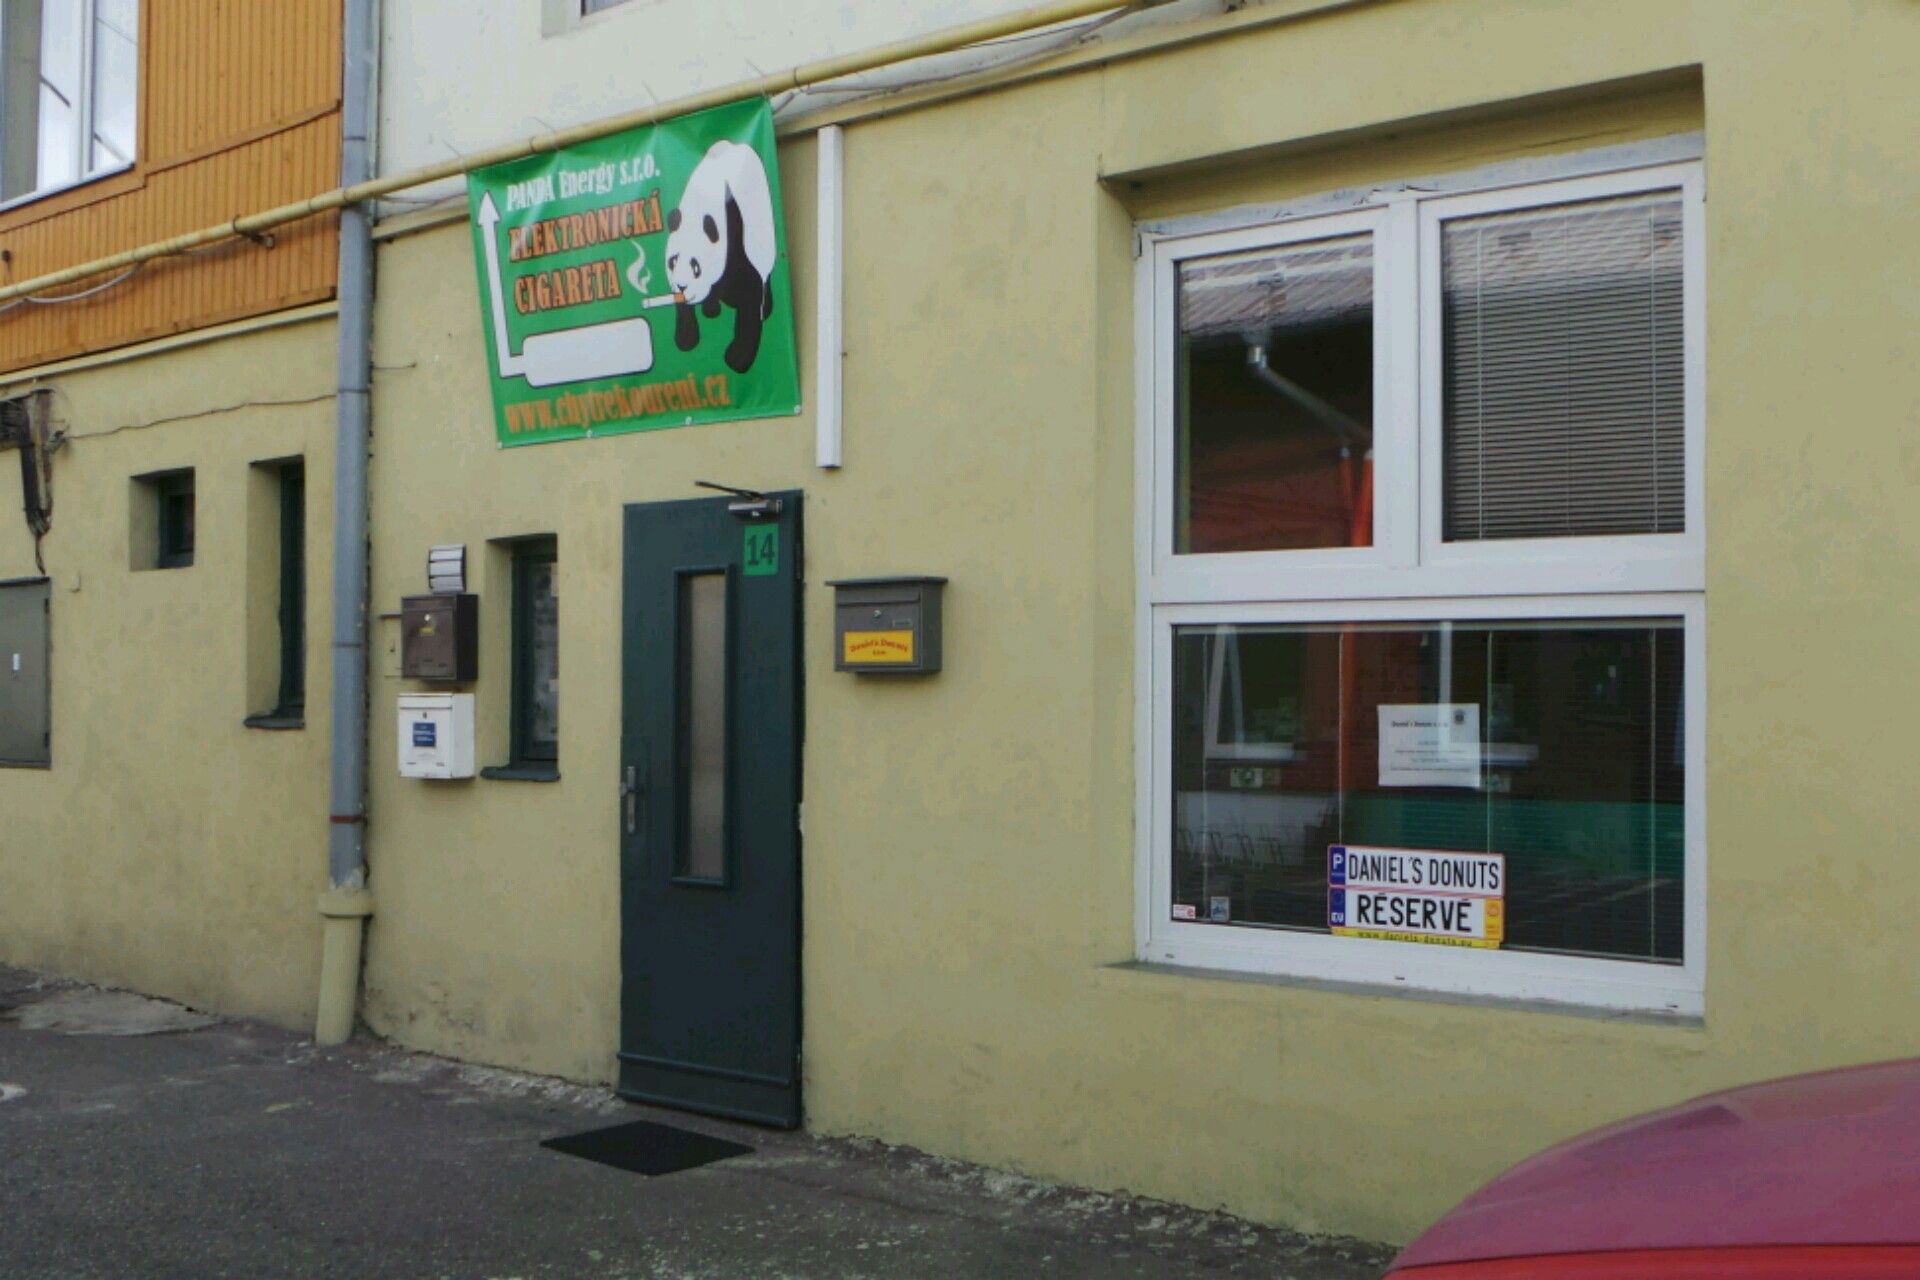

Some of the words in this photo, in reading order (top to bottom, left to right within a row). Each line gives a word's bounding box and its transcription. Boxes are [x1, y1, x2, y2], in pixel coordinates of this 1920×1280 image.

[506, 174, 555, 212] PANDA
[558, 162, 615, 198] Energy
[620, 153, 661, 185] s.r.o.
[508, 188, 664, 263] ELEKTRONICKÁ
[514, 258, 622, 315] CIGARETA
[748, 533, 775, 566] 14
[1333, 853, 1344, 870] P
[1429, 858, 1499, 890] DONUTS
